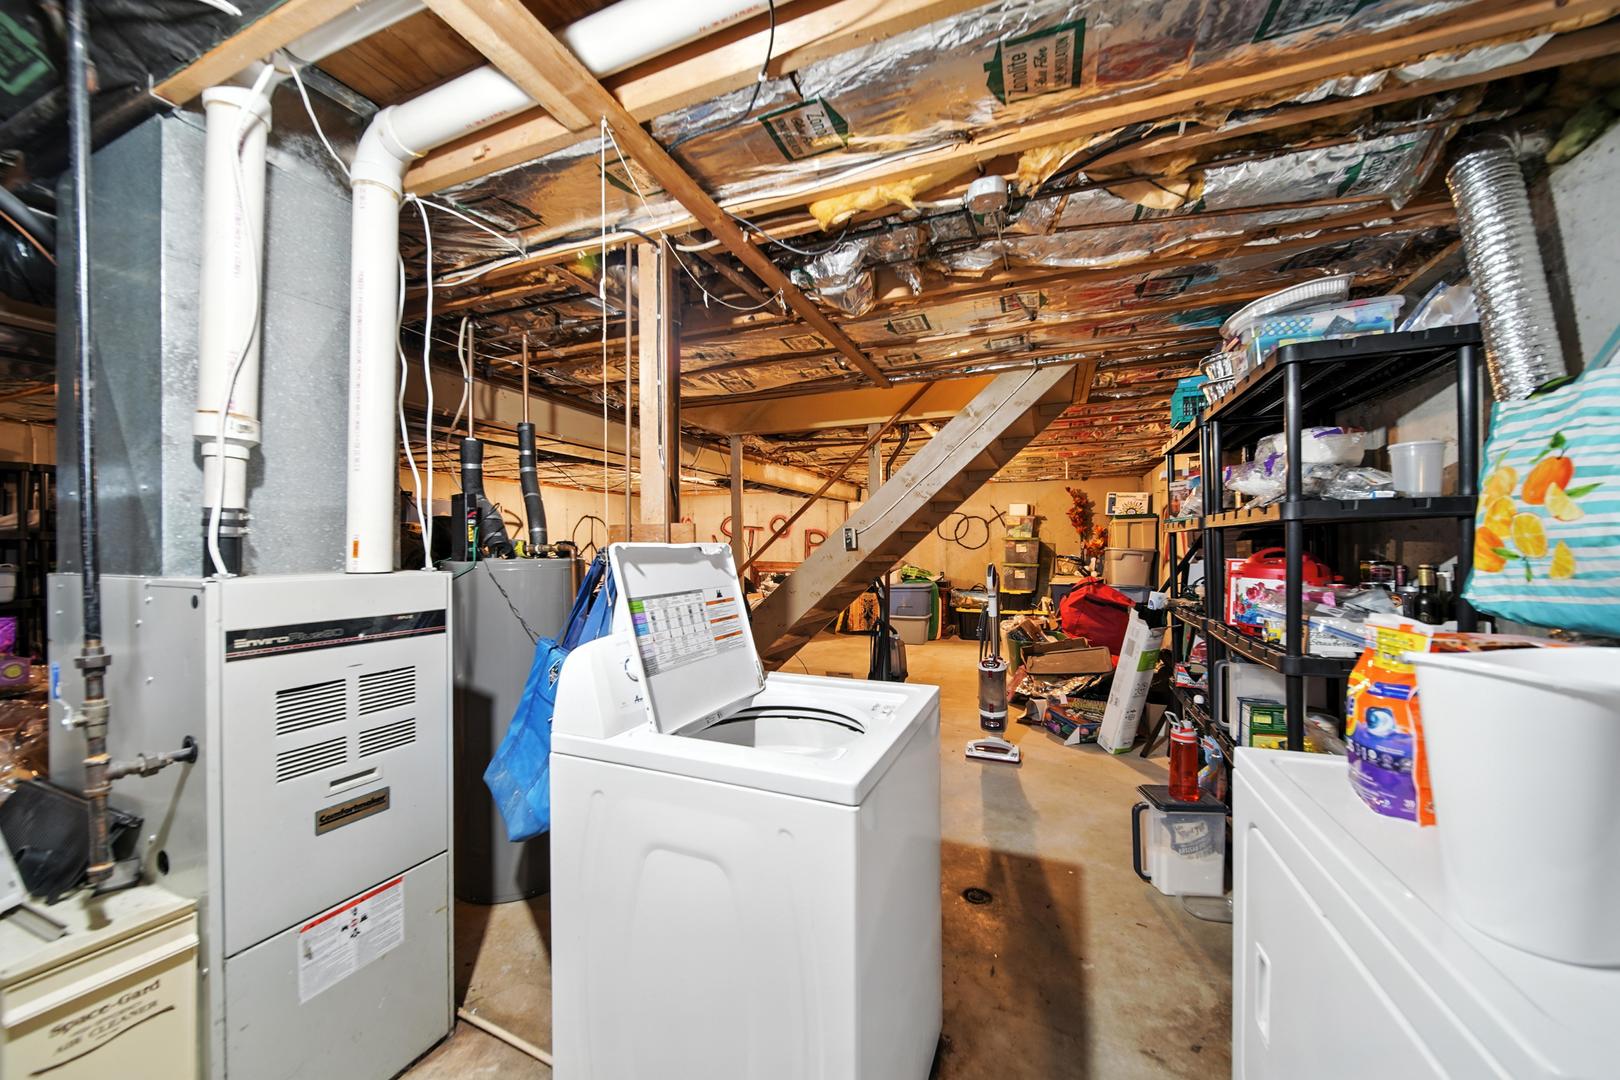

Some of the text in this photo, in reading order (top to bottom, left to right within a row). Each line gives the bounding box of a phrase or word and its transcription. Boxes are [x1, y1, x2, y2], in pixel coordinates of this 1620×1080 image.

[1004, 51, 1028, 97] Zonolite
[319, 794, 387, 823] Comfortmaker
[49, 978, 161, 1038] Space-Gard
